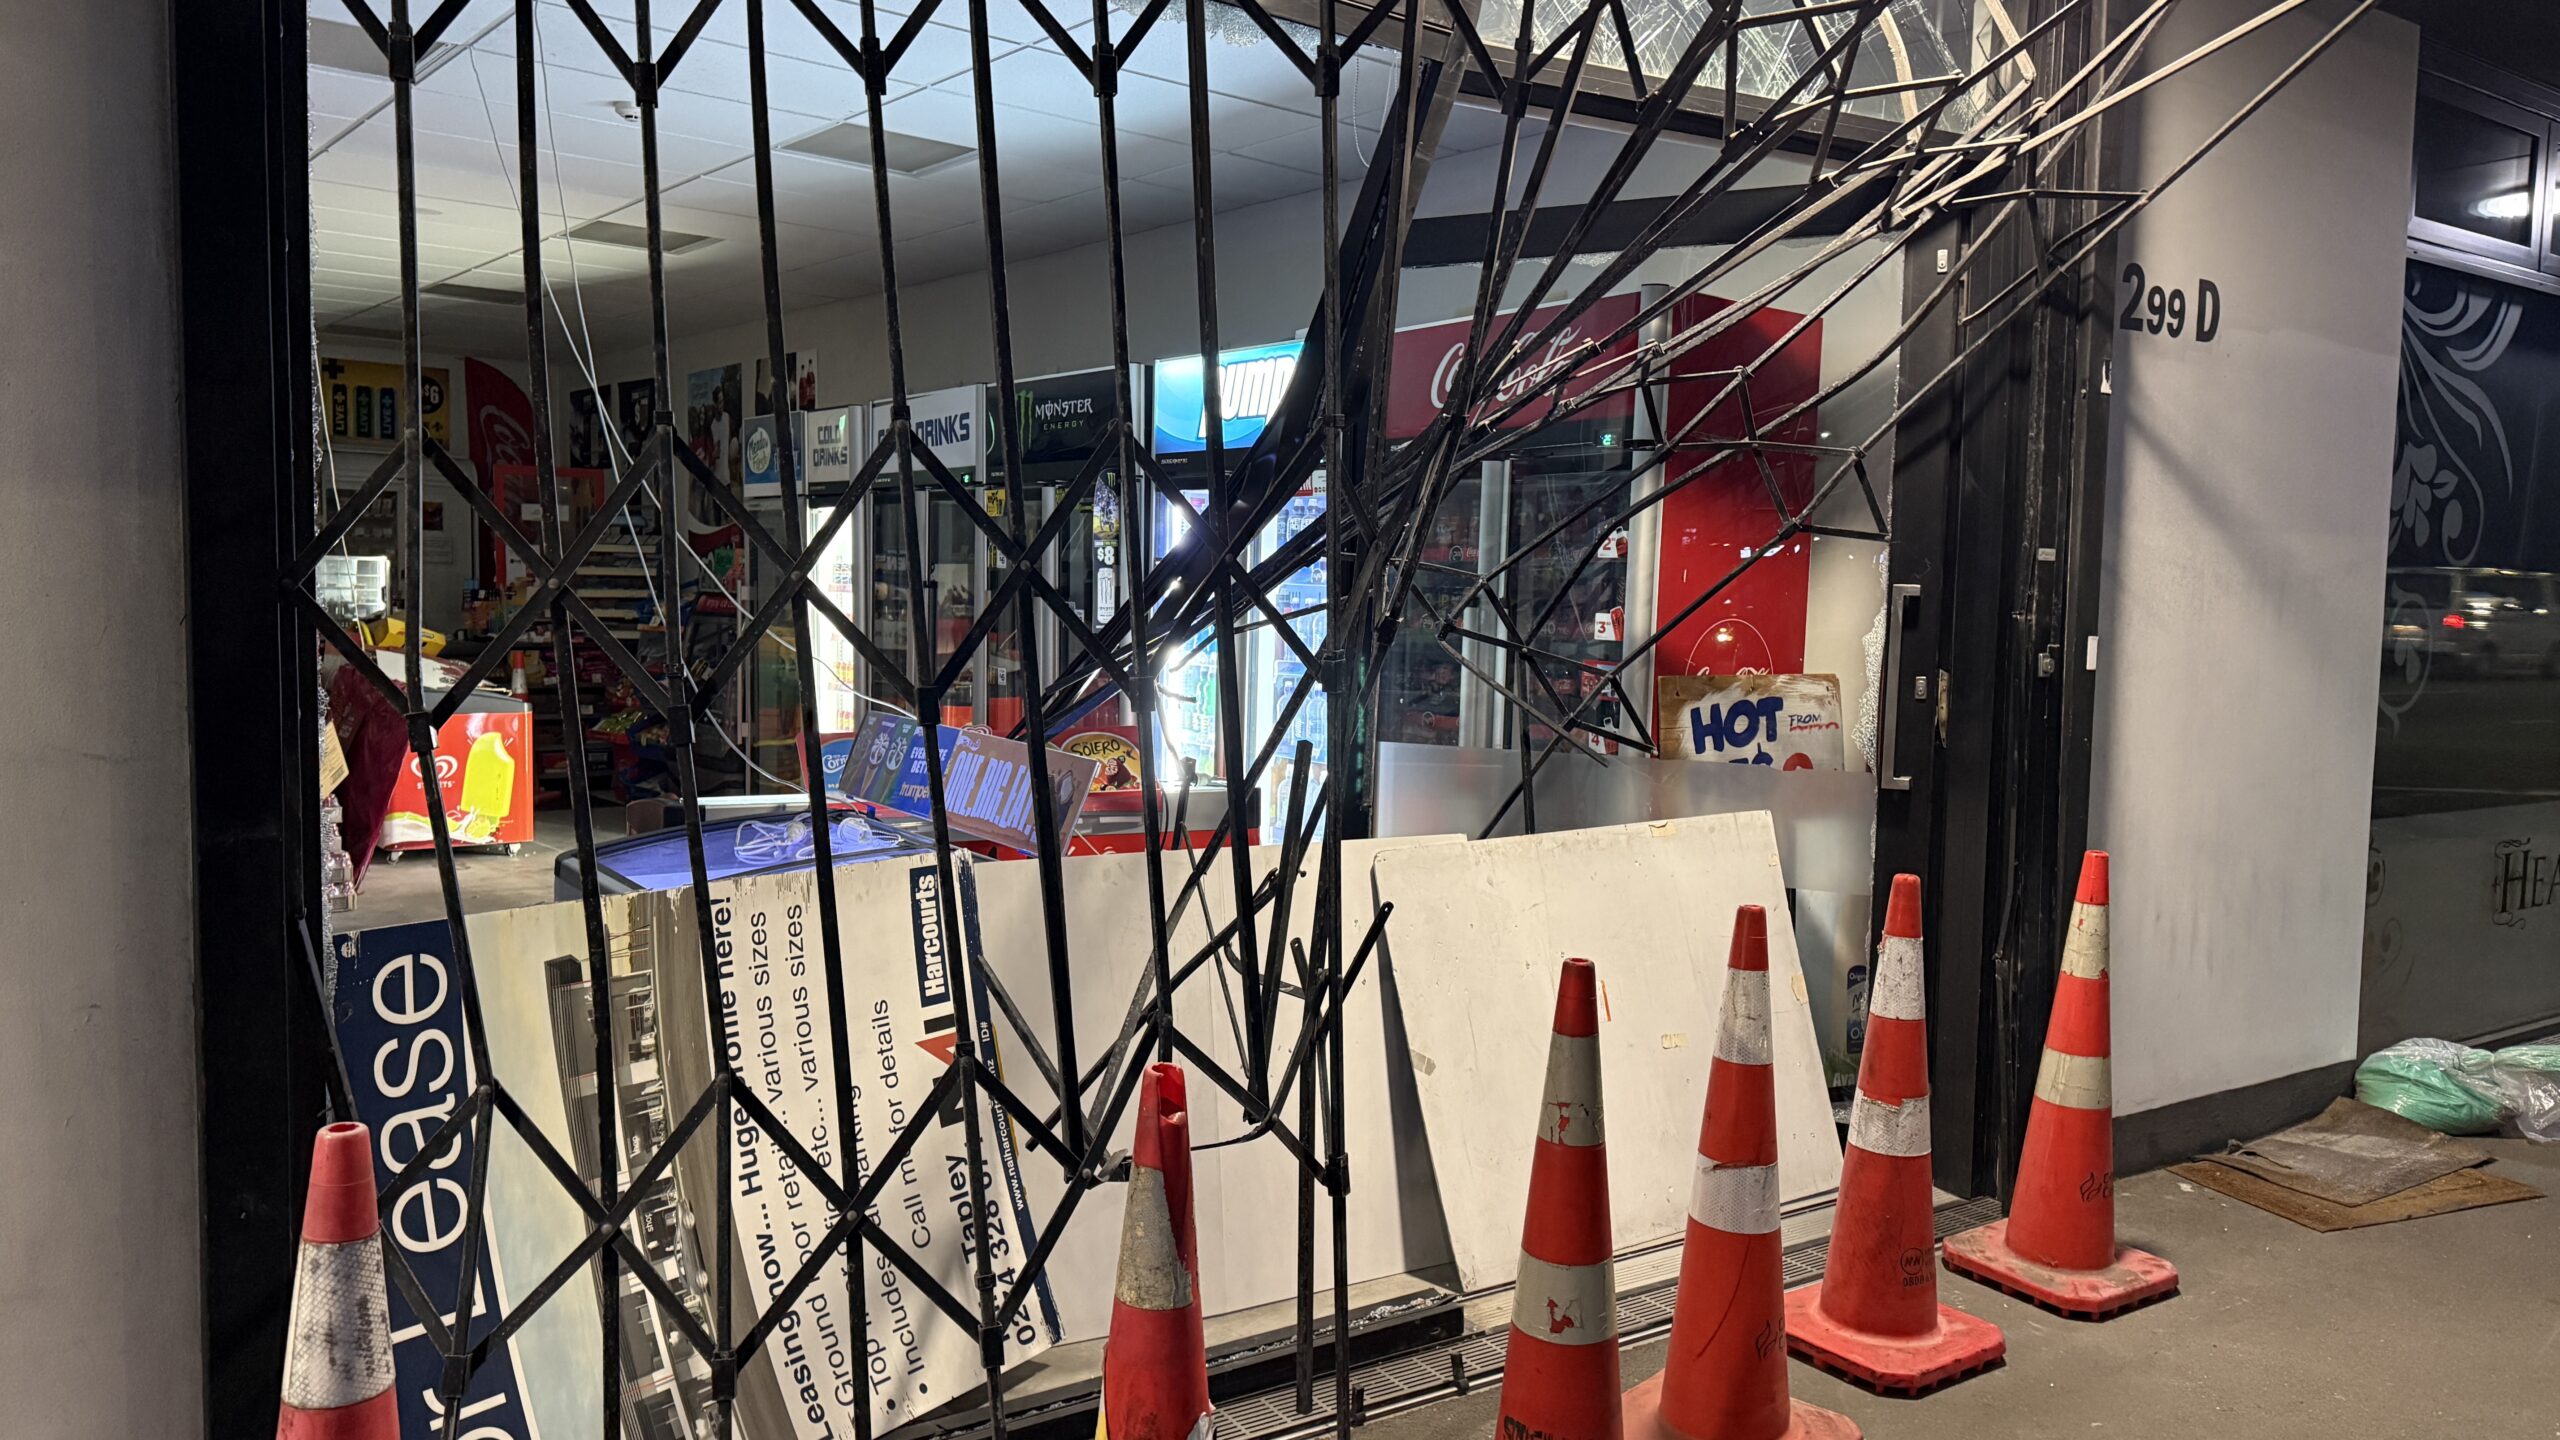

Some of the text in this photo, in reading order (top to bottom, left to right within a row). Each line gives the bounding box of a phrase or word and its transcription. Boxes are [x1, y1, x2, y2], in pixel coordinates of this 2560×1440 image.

[2120, 262, 2221, 343] 299 D
[915, 411, 970, 447] DRINKS
[1035, 398, 1093, 421] MONSTER
[1043, 420, 1085, 431] ENERGY
[813, 446, 848, 468] DRINKS
[1097, 546, 1115, 566] $8
[1070, 739, 1121, 757] SOLERO
[1690, 696, 1784, 755] HOT
[899, 781, 930, 802] trumpe
[748, 911, 770, 986] sizes
[784, 903, 806, 977] sizes
[915, 873, 946, 998] Harcourts
[757, 995, 784, 1104] various
[792, 986, 819, 1092] various
[871, 999, 900, 1089] details
[888, 1098, 908, 1135] for
[733, 1107, 763, 1197] Huge
[903, 1192, 931, 1249] Call
[876, 1256, 926, 1376] Includes
[805, 1293, 856, 1407] Ground
[866, 1337, 892, 1396] Top
